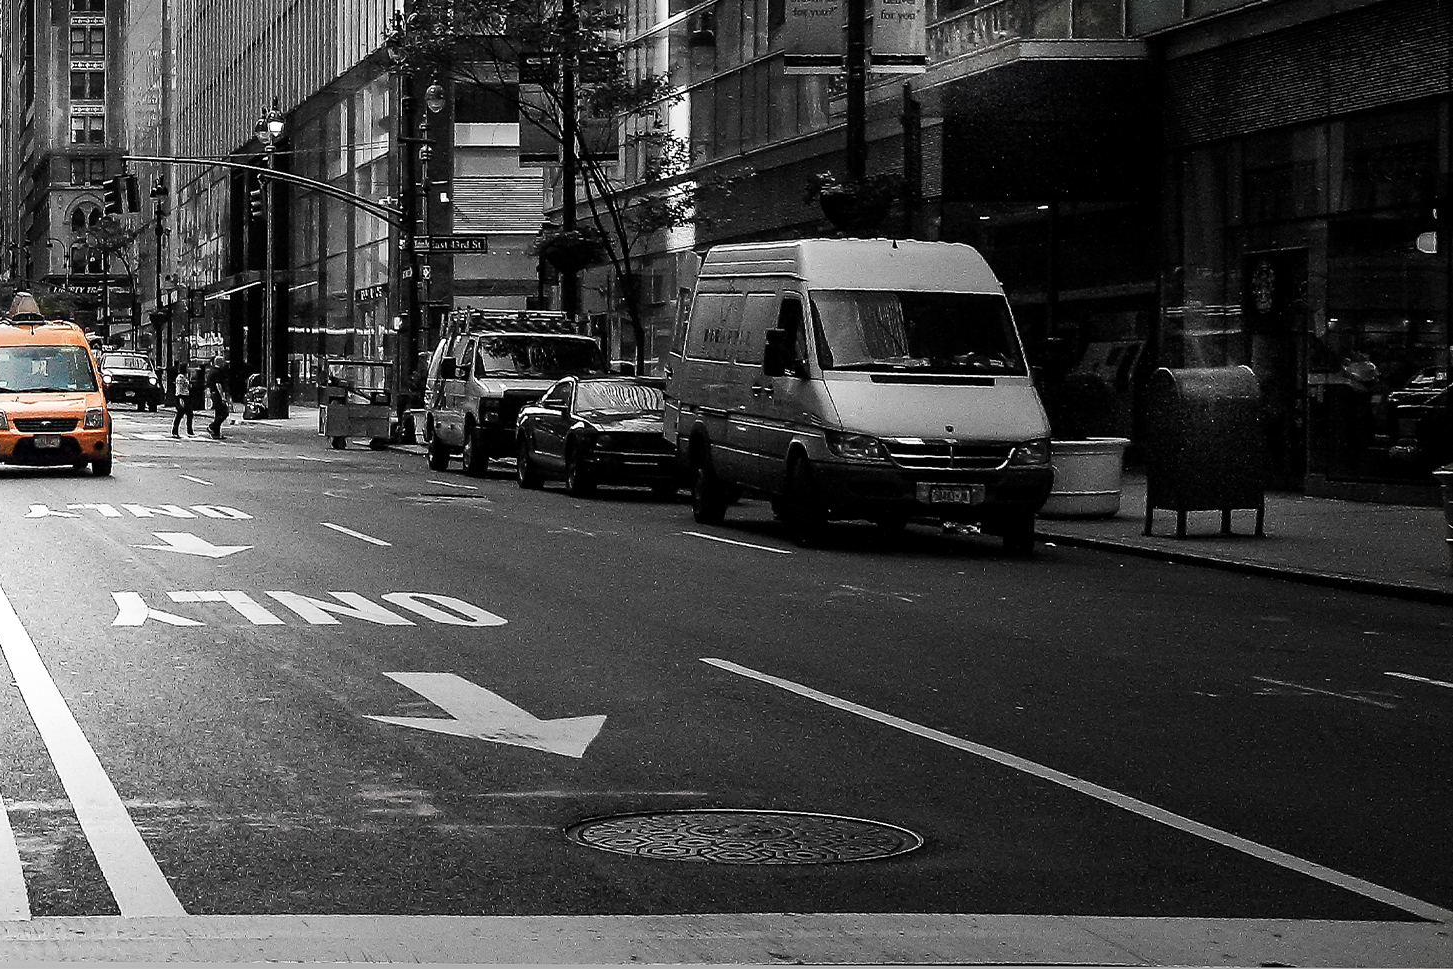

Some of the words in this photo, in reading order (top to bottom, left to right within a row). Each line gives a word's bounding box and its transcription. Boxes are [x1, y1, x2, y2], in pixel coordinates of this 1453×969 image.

[792, 7, 808, 17] for
[880, 9, 896, 19] for
[451, 240, 470, 249] 43rd
[472, 240, 482, 249] St
[25, 502, 254, 520] ONLY
[110, 589, 508, 629] ONLY
